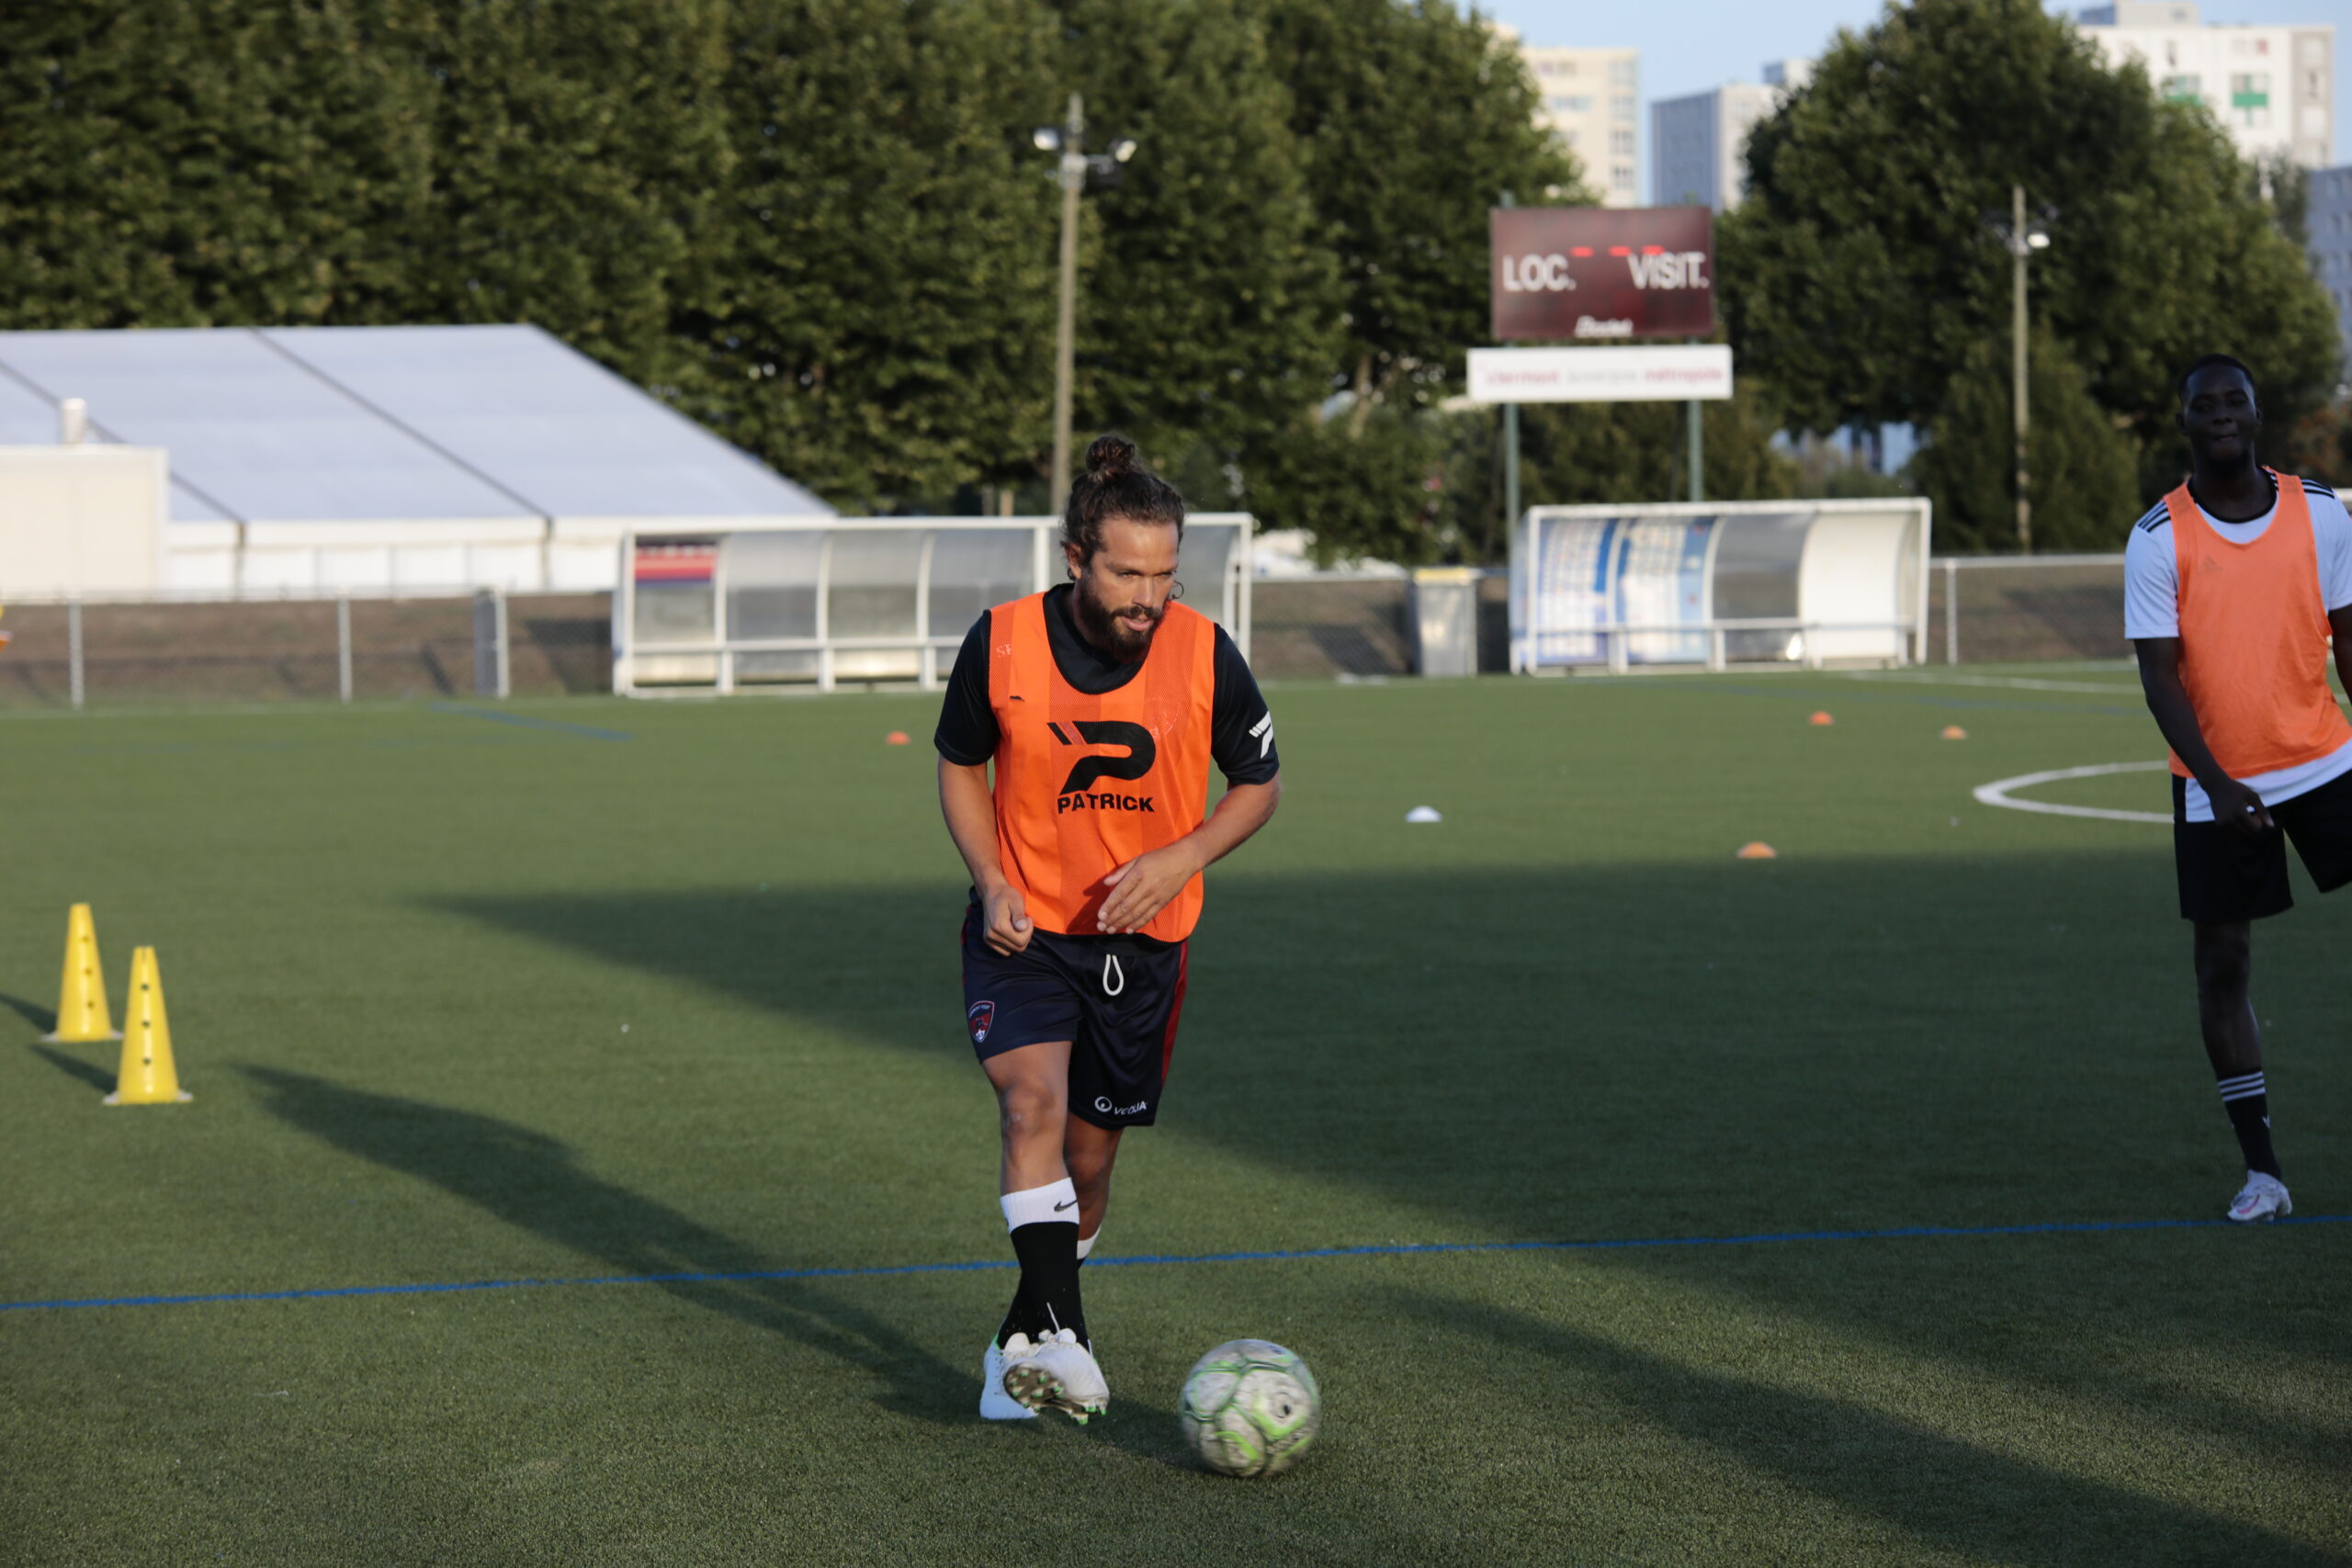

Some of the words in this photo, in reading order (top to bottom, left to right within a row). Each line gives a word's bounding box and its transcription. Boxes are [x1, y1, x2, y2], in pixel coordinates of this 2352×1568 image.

[1502, 254, 1577, 292] LOC.
[1627, 252, 1710, 290] VISIT.
[1057, 793, 1155, 815] PATRICK
